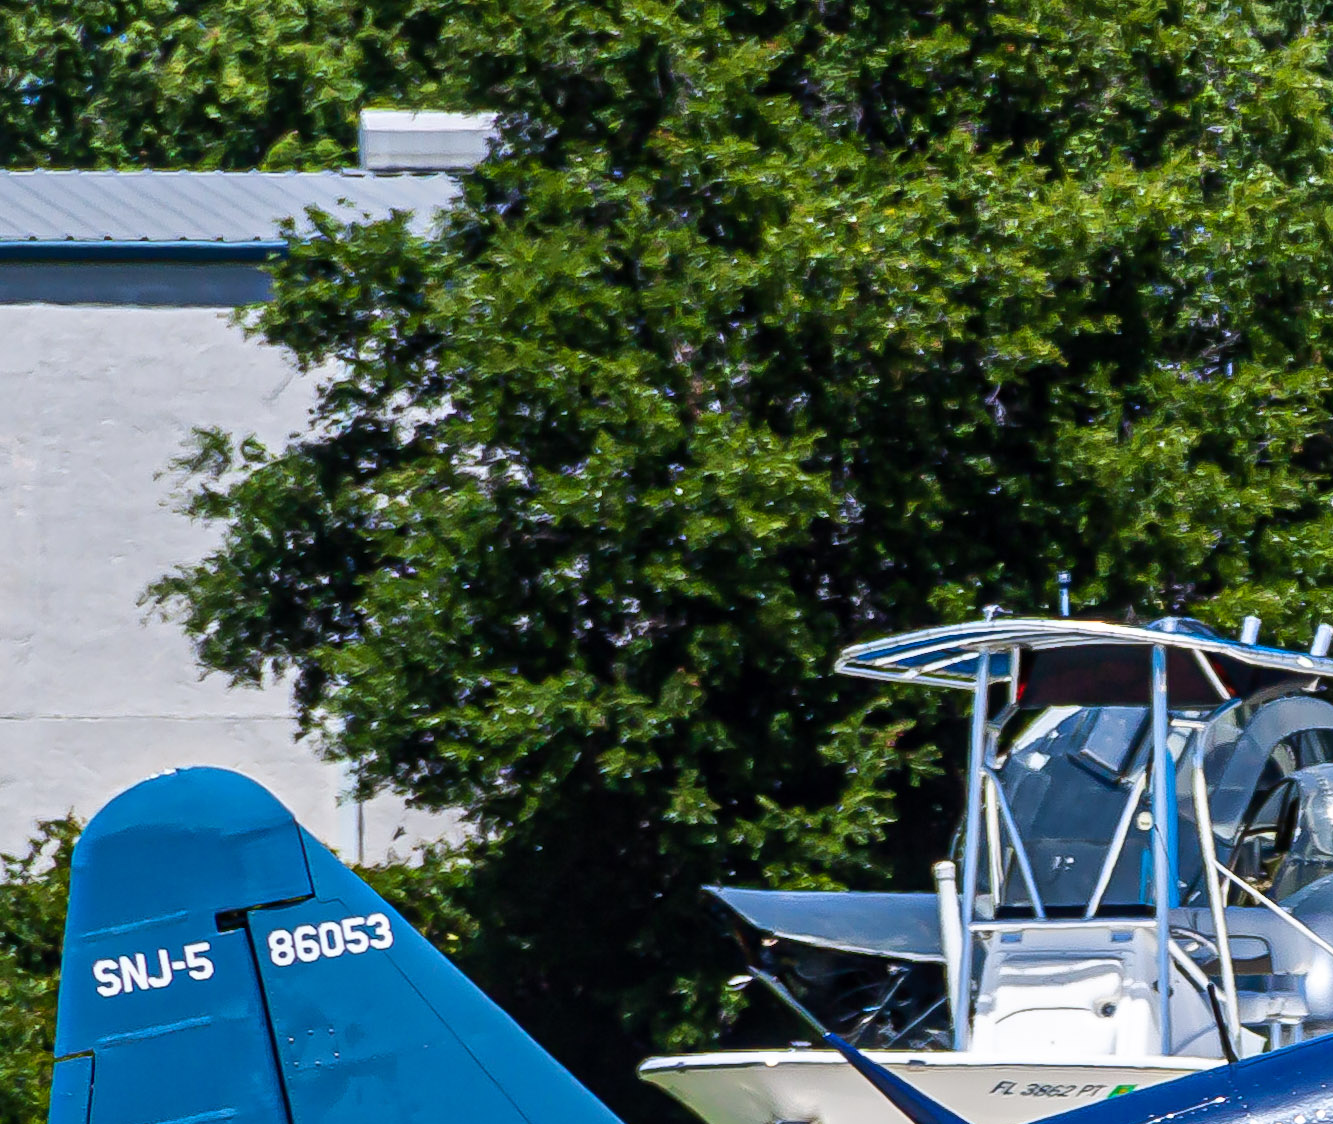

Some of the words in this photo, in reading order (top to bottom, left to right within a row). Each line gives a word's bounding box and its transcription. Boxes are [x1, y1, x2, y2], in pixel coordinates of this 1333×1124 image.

[92, 941, 215, 998] SNJ-5
[267, 912, 395, 967] 86053
[990, 1080, 1018, 1096] FL
[1020, 1083, 1077, 1098] 3862
[1076, 1084, 1108, 1098] PT
